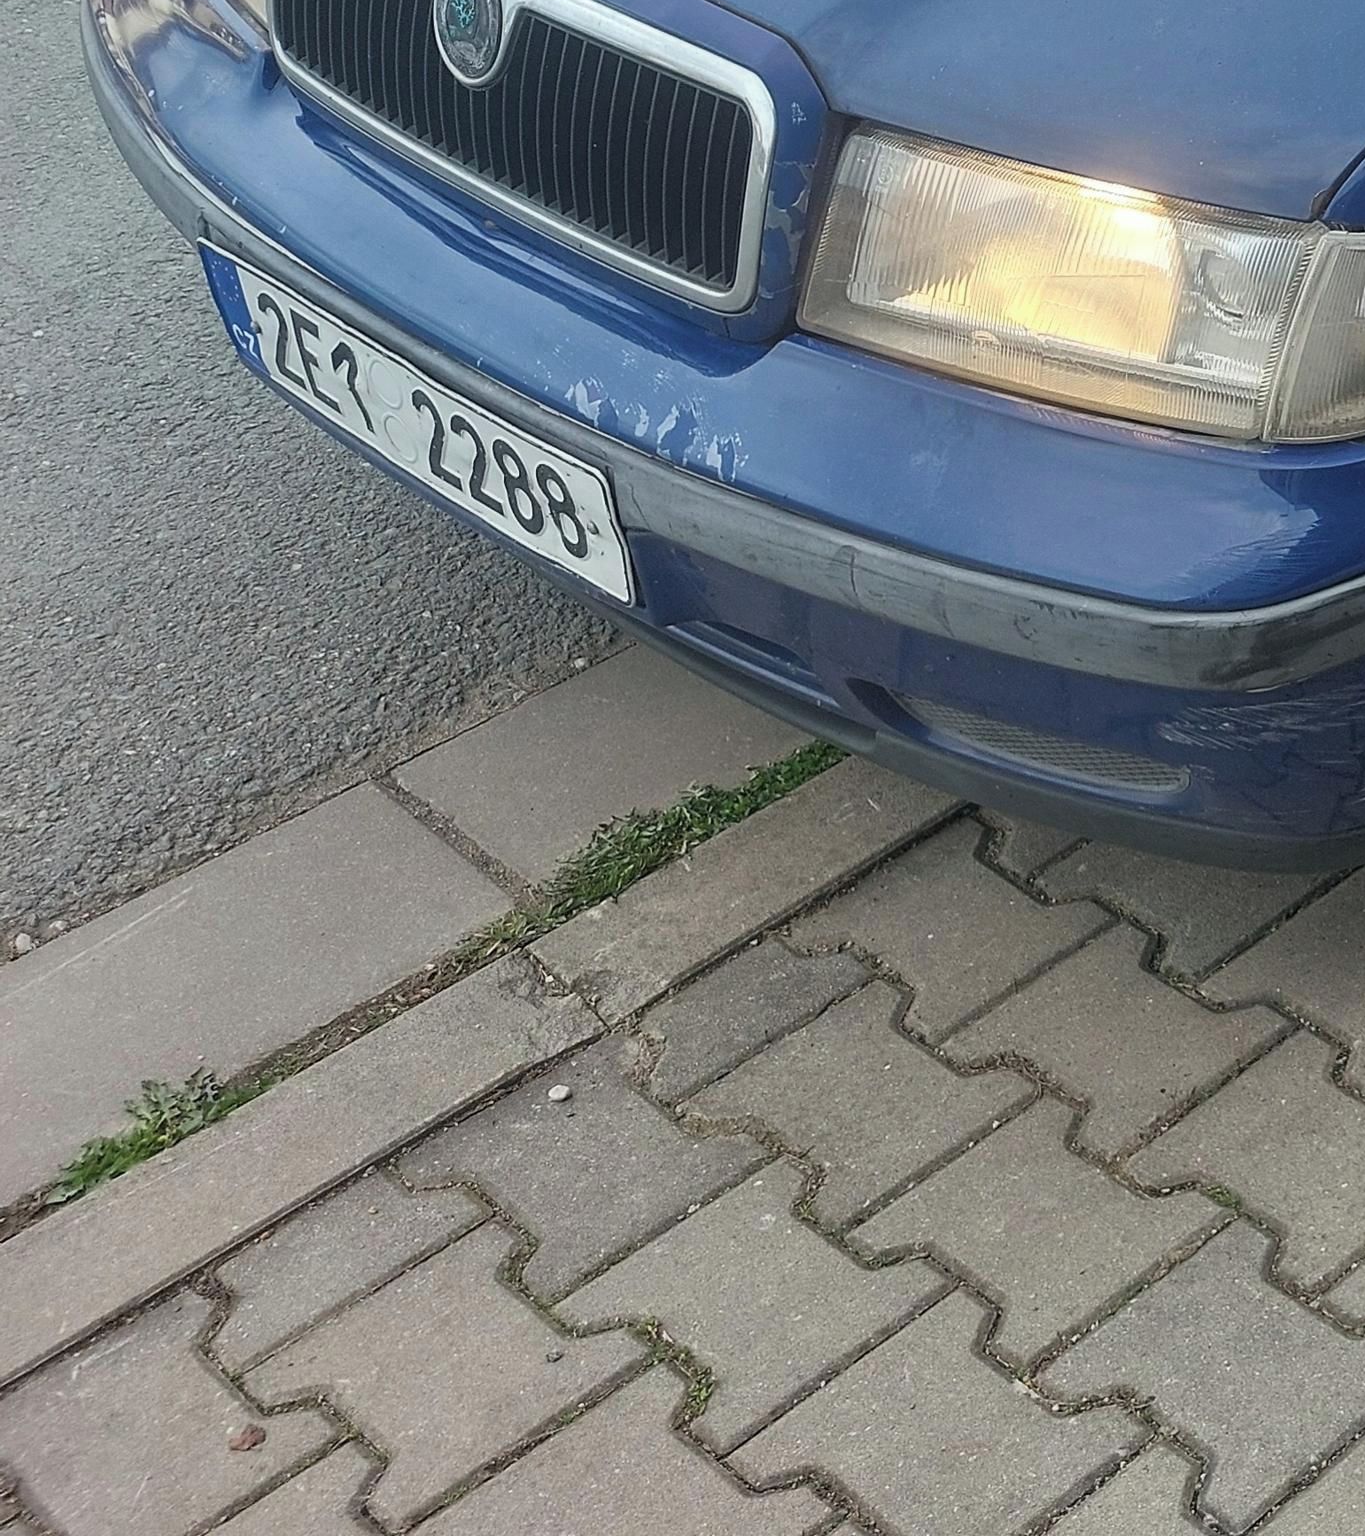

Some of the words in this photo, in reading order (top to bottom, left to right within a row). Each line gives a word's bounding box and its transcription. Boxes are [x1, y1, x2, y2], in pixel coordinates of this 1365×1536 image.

[232, 323, 260, 360] CZ
[258, 293, 375, 434] 2E1
[412, 389, 590, 559] 2288
